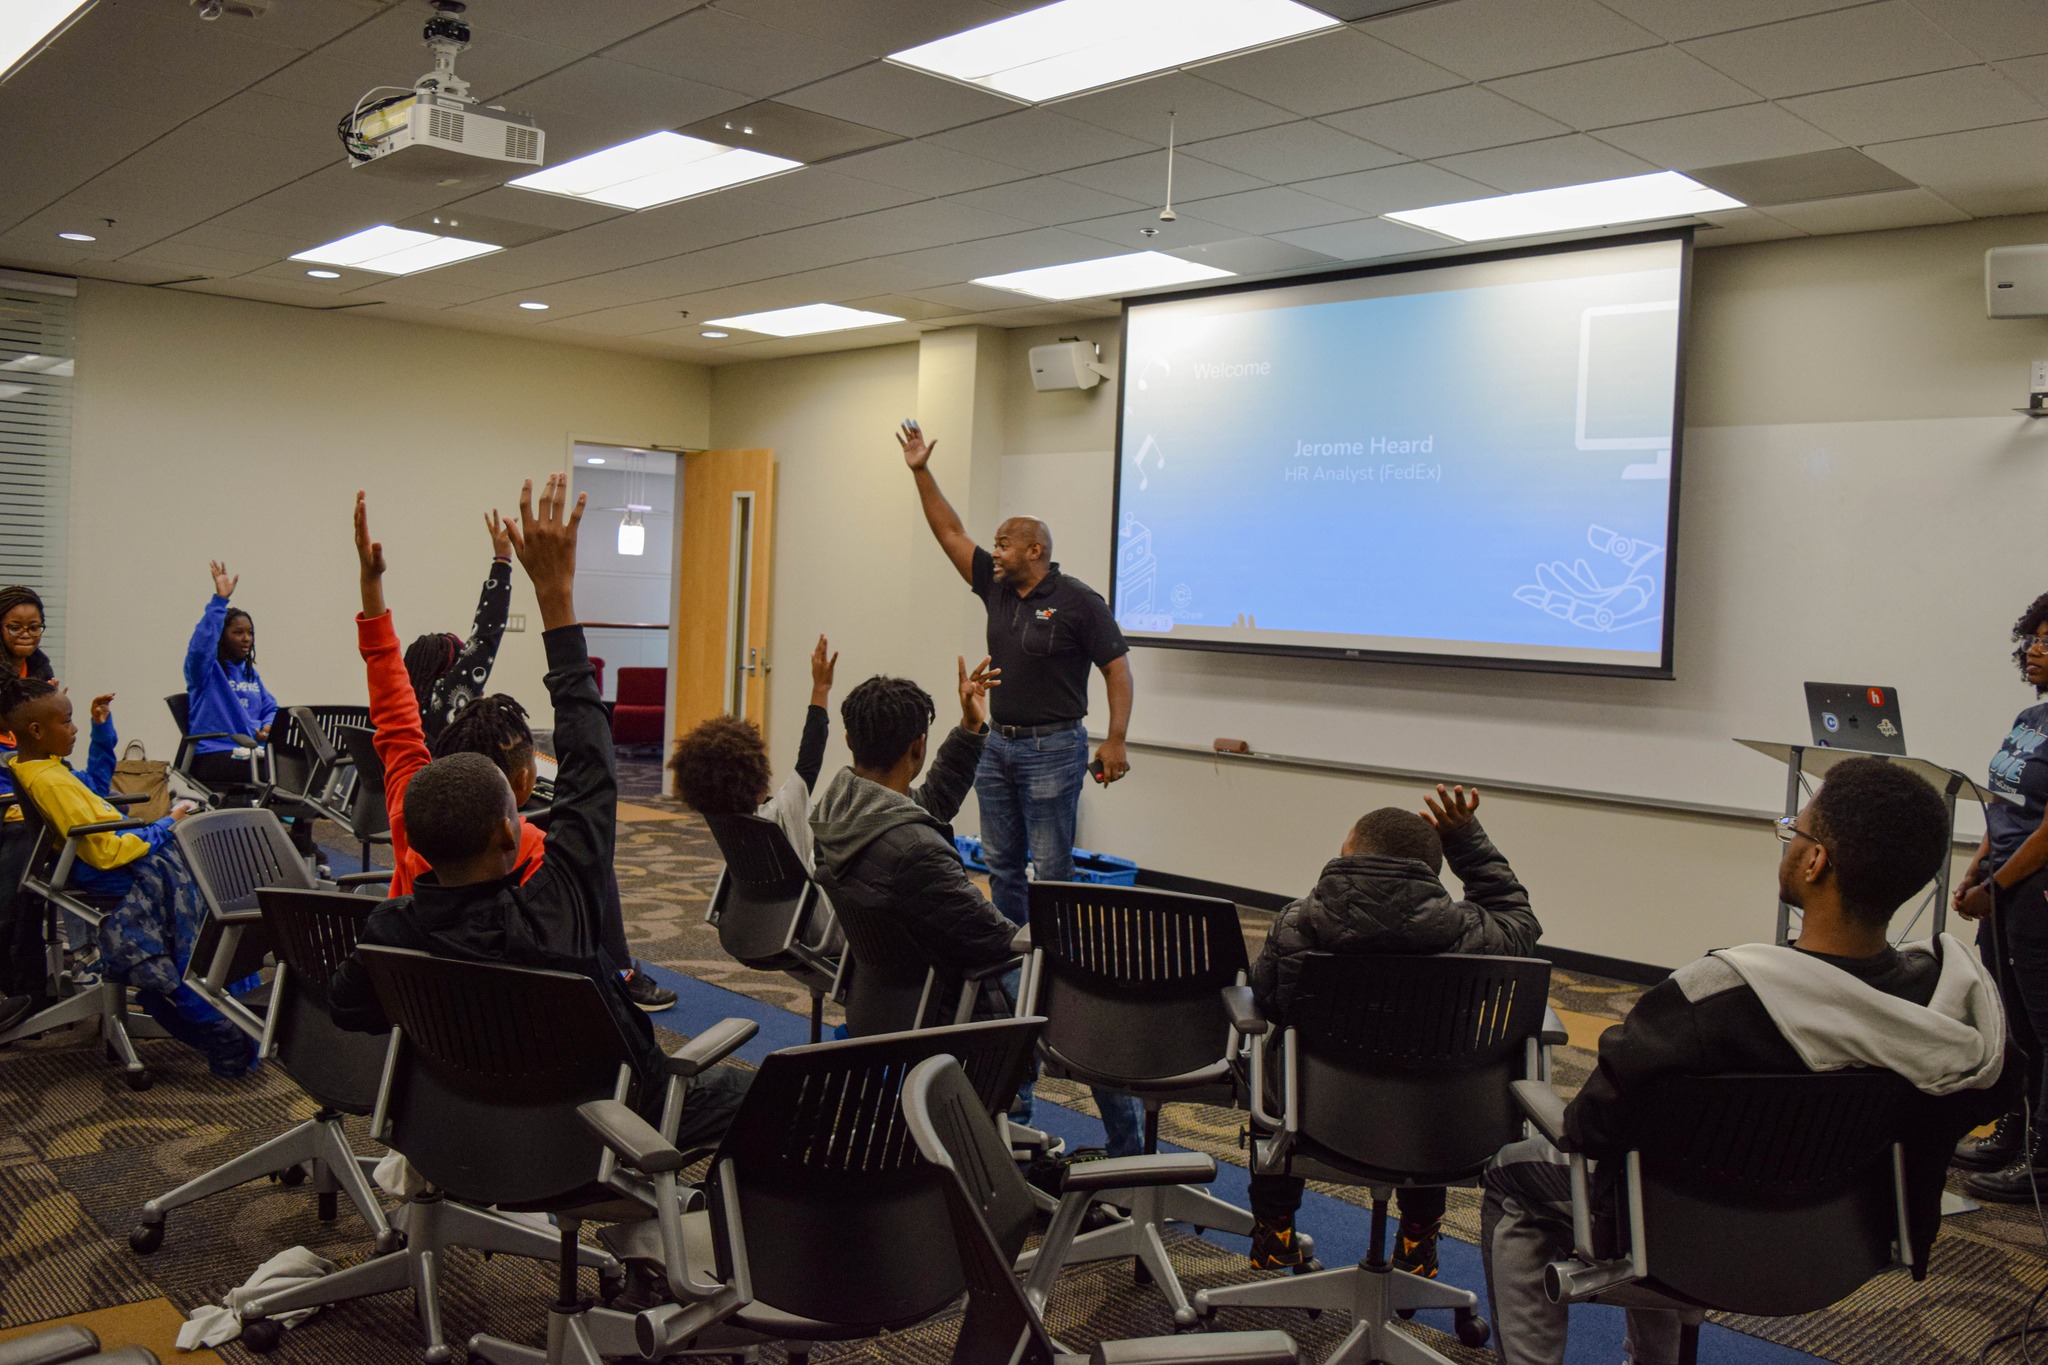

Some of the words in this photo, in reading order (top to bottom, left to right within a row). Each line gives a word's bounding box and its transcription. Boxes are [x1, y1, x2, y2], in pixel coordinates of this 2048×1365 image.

[1194, 361, 1271, 379] Welcome
[1294, 439, 1363, 458] Jerome
[1370, 435, 1433, 454] Heard
[1285, 466, 1309, 482] HR
[1313, 465, 1374, 483] Analyst
[1379, 463, 1442, 483] (FedEx)
